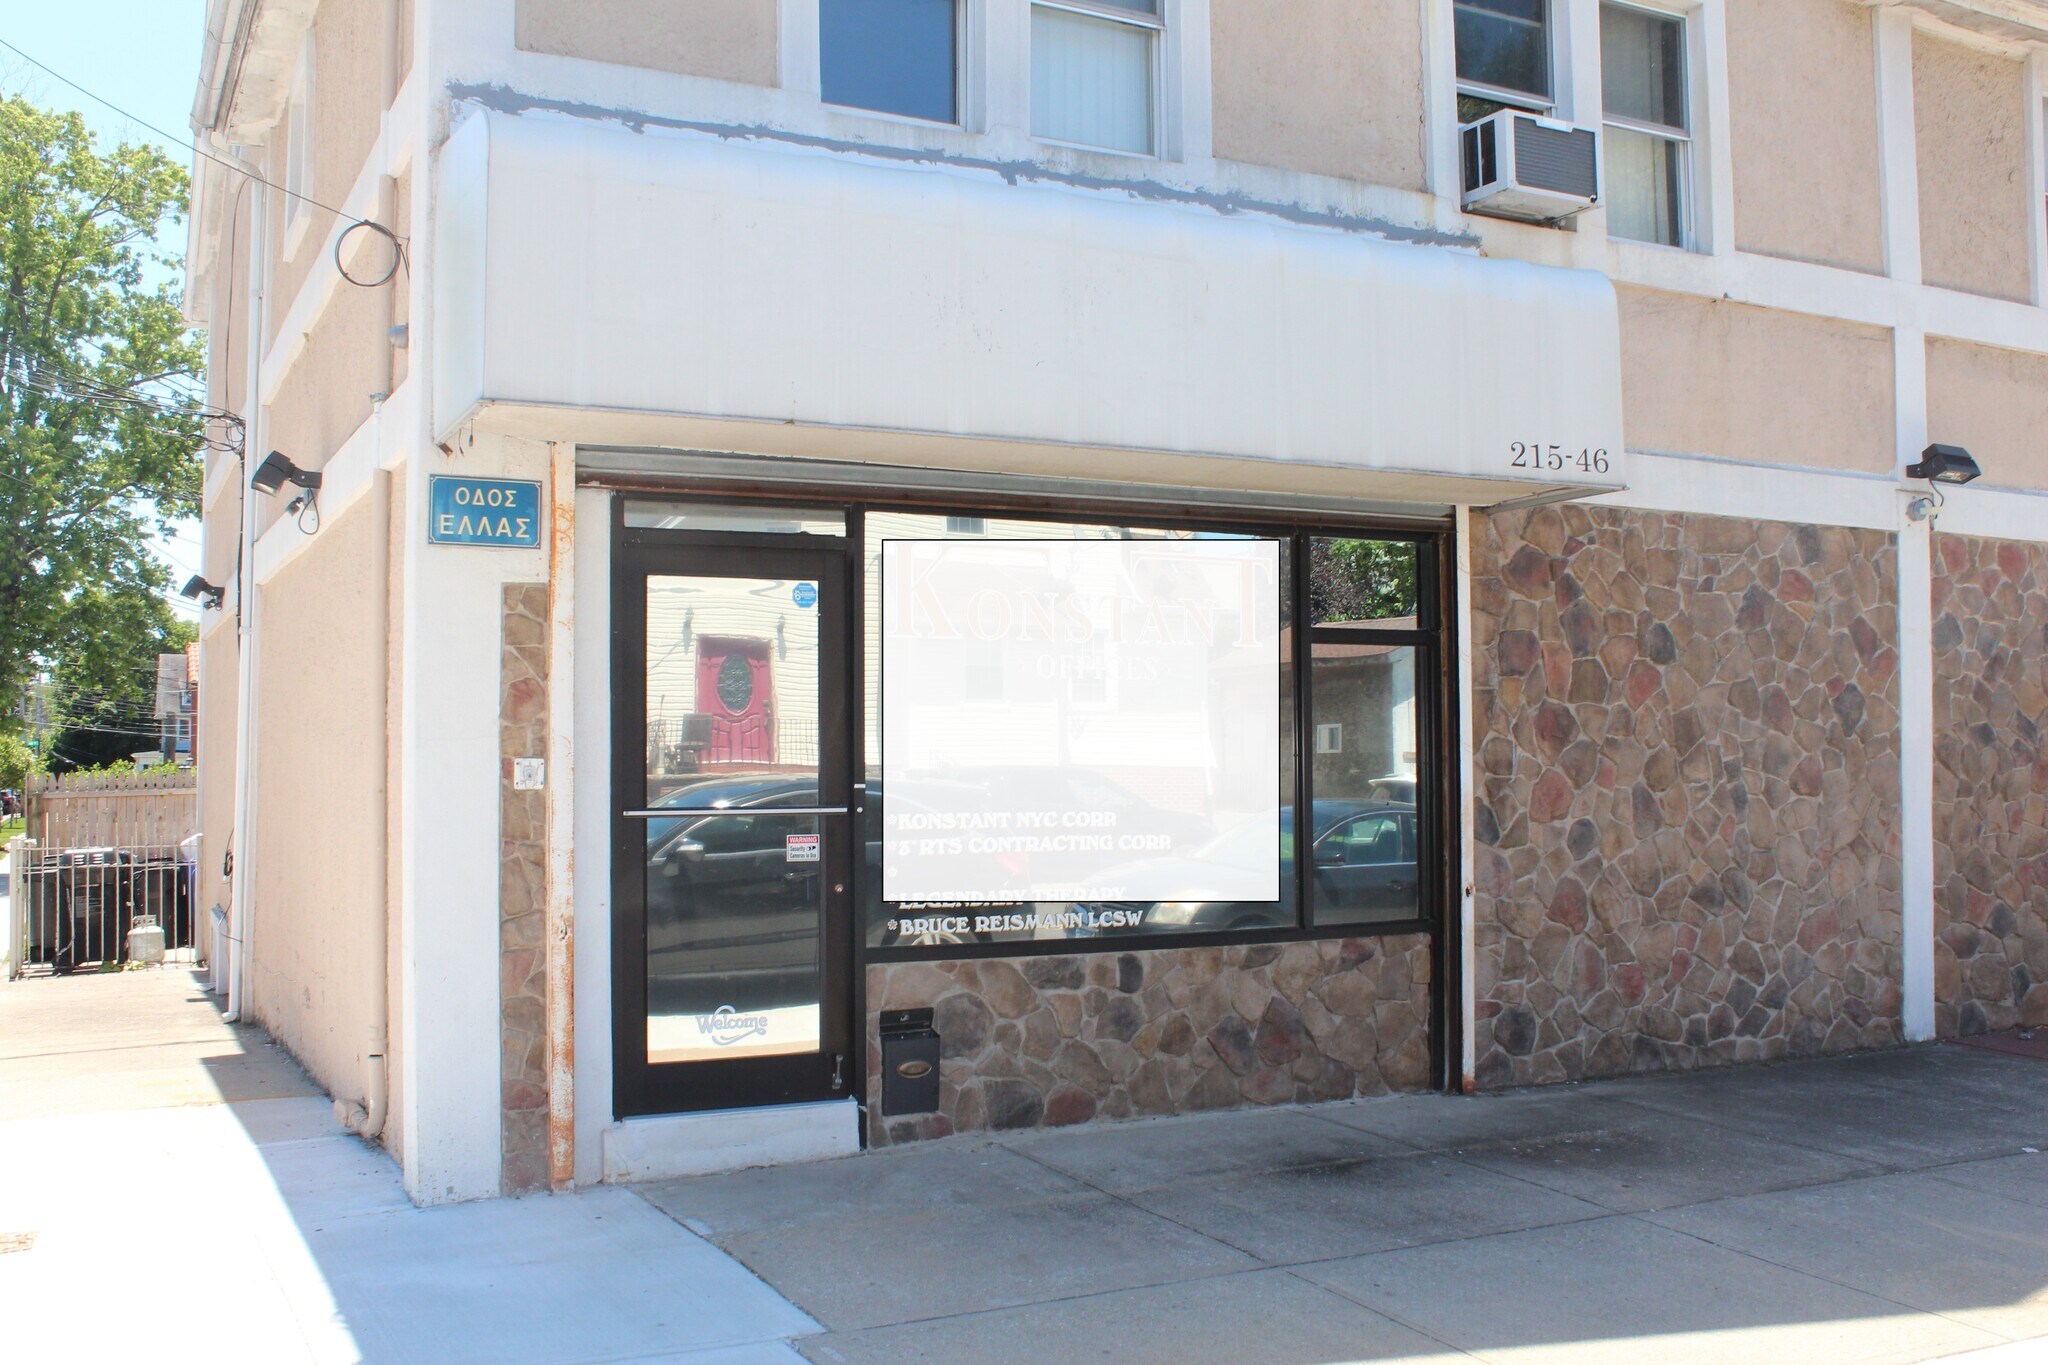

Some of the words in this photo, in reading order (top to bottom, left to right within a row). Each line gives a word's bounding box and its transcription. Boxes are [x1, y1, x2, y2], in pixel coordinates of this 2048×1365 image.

[1510, 441, 1609, 473] 215-46
[455, 487, 517, 508] ΟΔΟΣ
[439, 514, 531, 539] ΕΛΛΑΣ
[897, 812, 1011, 830] KONSTANT
[1016, 811, 1057, 828] NYC
[968, 834, 1114, 854] CONTRACTING
[898, 889, 1026, 910] LEGENDARY
[900, 916, 970, 936] BRUCE
[975, 913, 1083, 933] REISMANN
[1087, 910, 1143, 928] LCSW
[695, 1004, 768, 1046] Welcome
